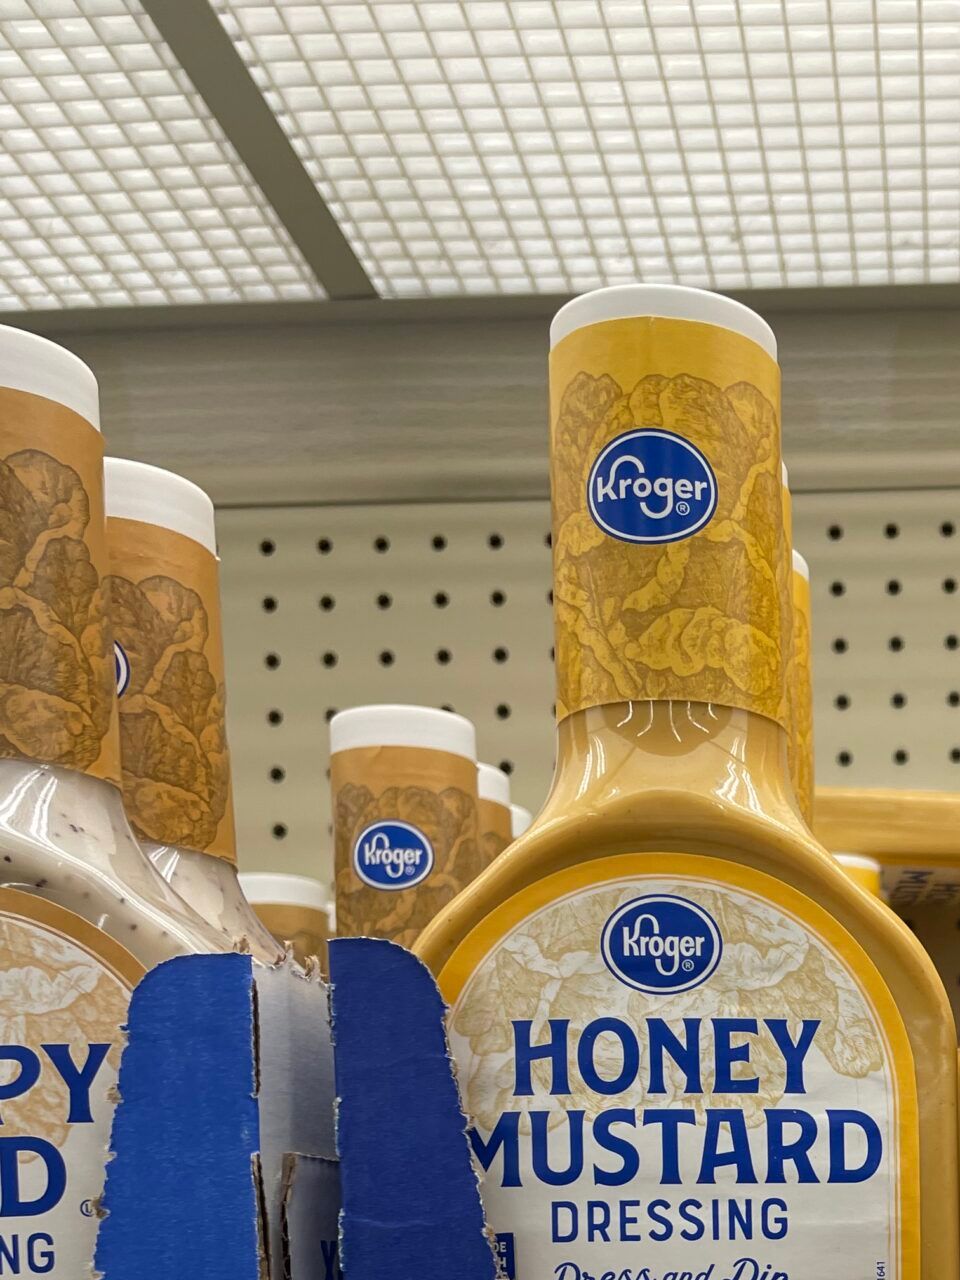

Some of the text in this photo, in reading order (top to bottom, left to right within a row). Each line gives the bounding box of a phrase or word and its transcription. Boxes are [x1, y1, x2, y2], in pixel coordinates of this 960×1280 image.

[597, 455, 708, 519] Kroger
[363, 836, 423, 878] Kroger
[622, 913, 704, 975] Kroger
[511, 1017, 822, 1096] HONEY
[463, 1108, 883, 1188] MUSTARD
[551, 1197, 789, 1243] DRESSING
